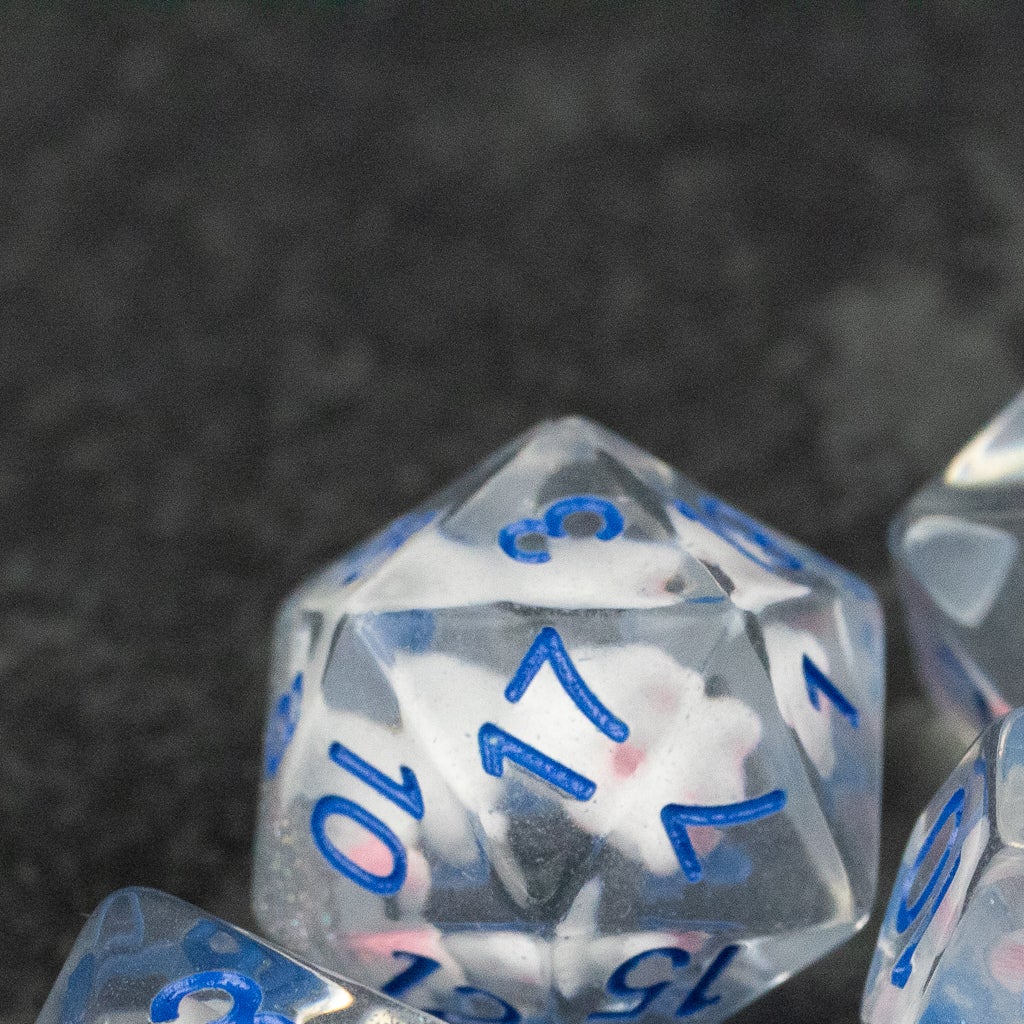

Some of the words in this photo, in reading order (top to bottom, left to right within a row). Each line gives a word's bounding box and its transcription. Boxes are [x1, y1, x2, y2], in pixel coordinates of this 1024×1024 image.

[499, 495, 624, 564] 3
[477, 626, 630, 801] 17
[311, 740, 425, 896] 10
[660, 789, 786, 881] 7
[585, 944, 742, 1021] 15
